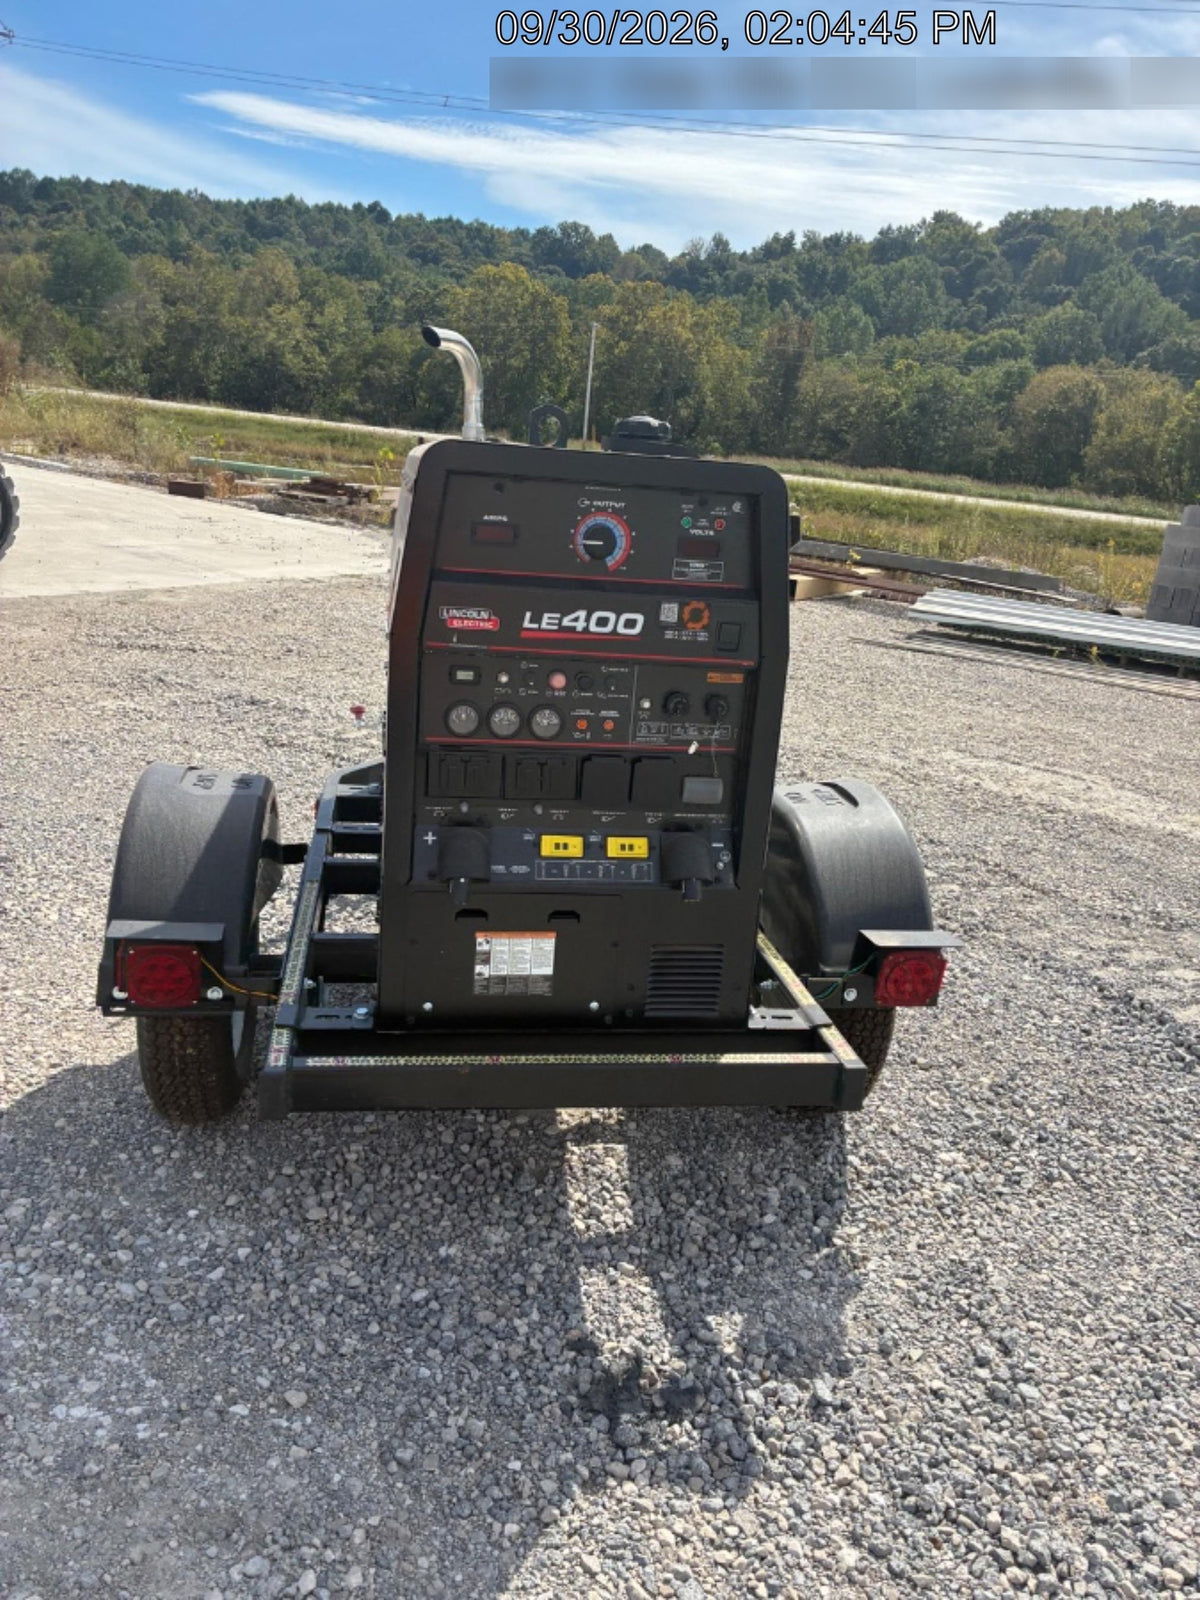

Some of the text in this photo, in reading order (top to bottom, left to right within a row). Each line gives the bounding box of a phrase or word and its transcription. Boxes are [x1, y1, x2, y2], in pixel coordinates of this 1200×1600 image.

[592, 500, 627, 509] OUTPUT
[442, 607, 490, 620] LINCOLN
[452, 618, 495, 629] ELECTRIC
[522, 609, 645, 636] LE400
